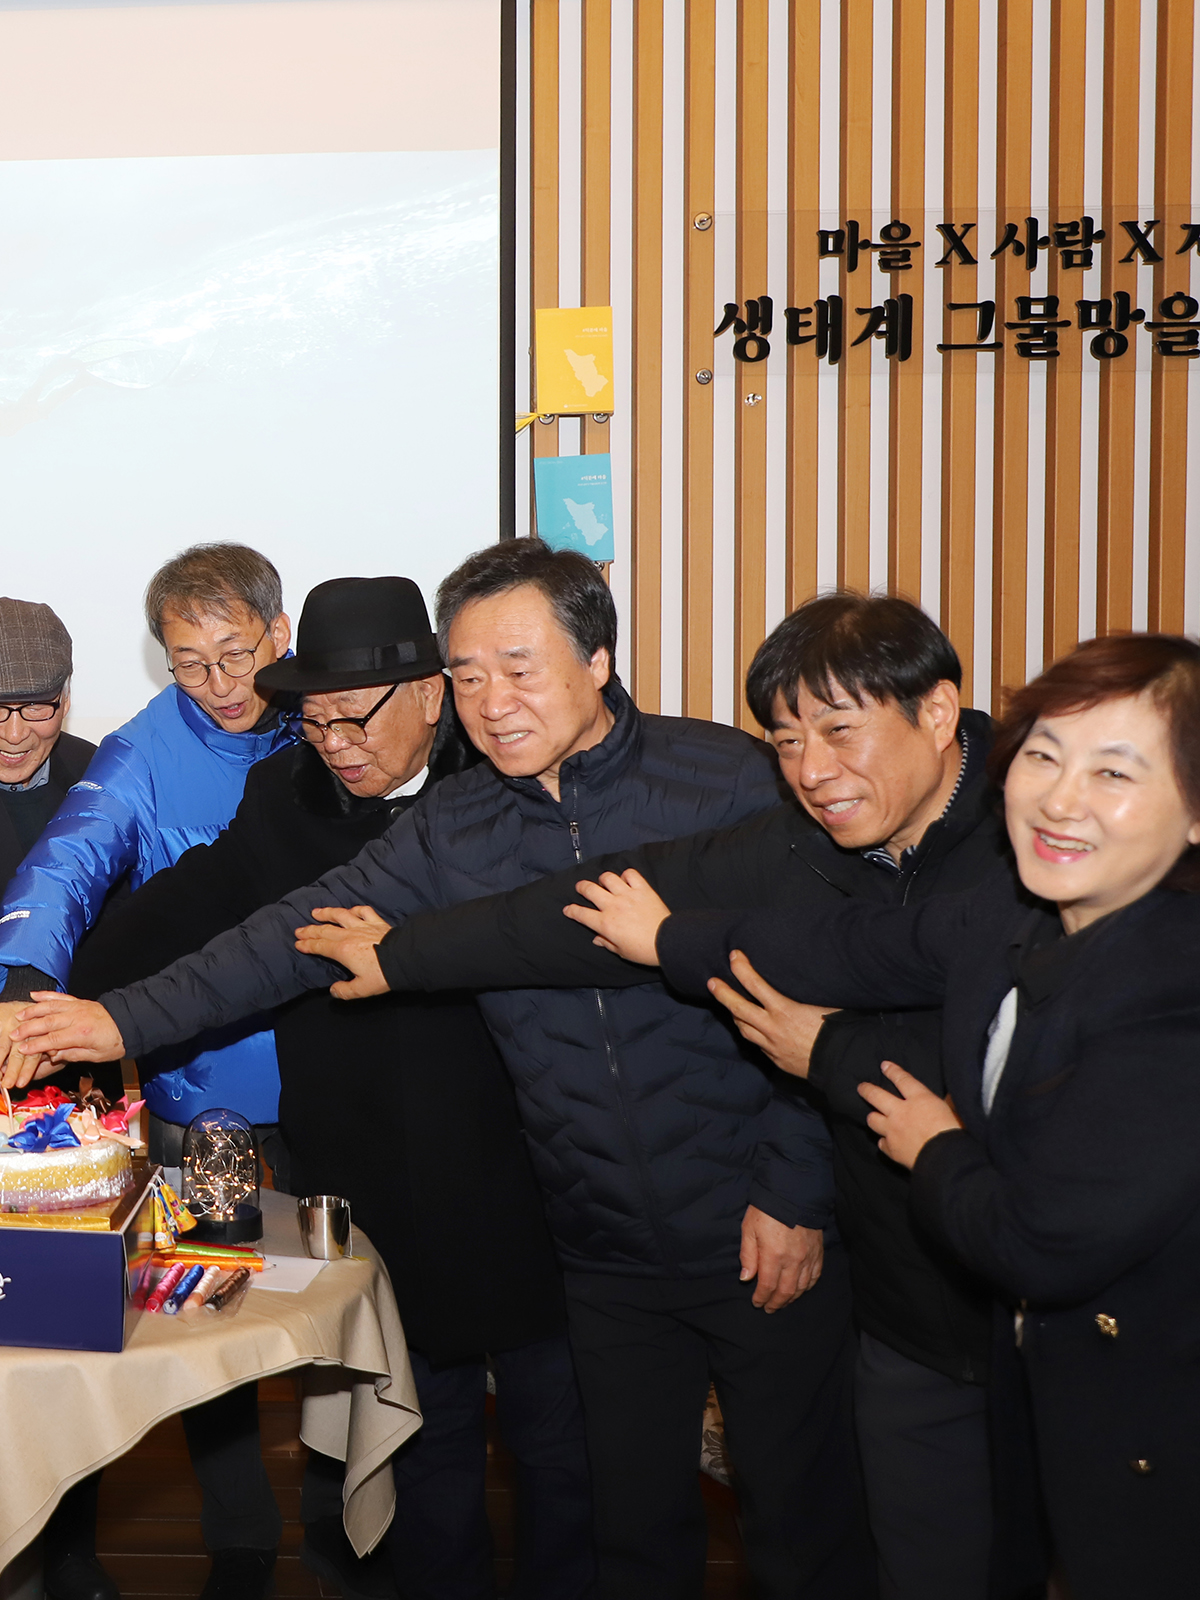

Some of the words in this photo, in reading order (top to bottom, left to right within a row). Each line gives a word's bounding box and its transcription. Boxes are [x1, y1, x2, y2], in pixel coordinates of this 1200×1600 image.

[817, 219, 921, 273] 마을
[935, 223, 978, 267] X
[990, 216, 1105, 270] 사람
[1118, 219, 1163, 264] X
[714, 293, 914, 365] 생태계
[936, 290, 1200, 360] 그물망을
